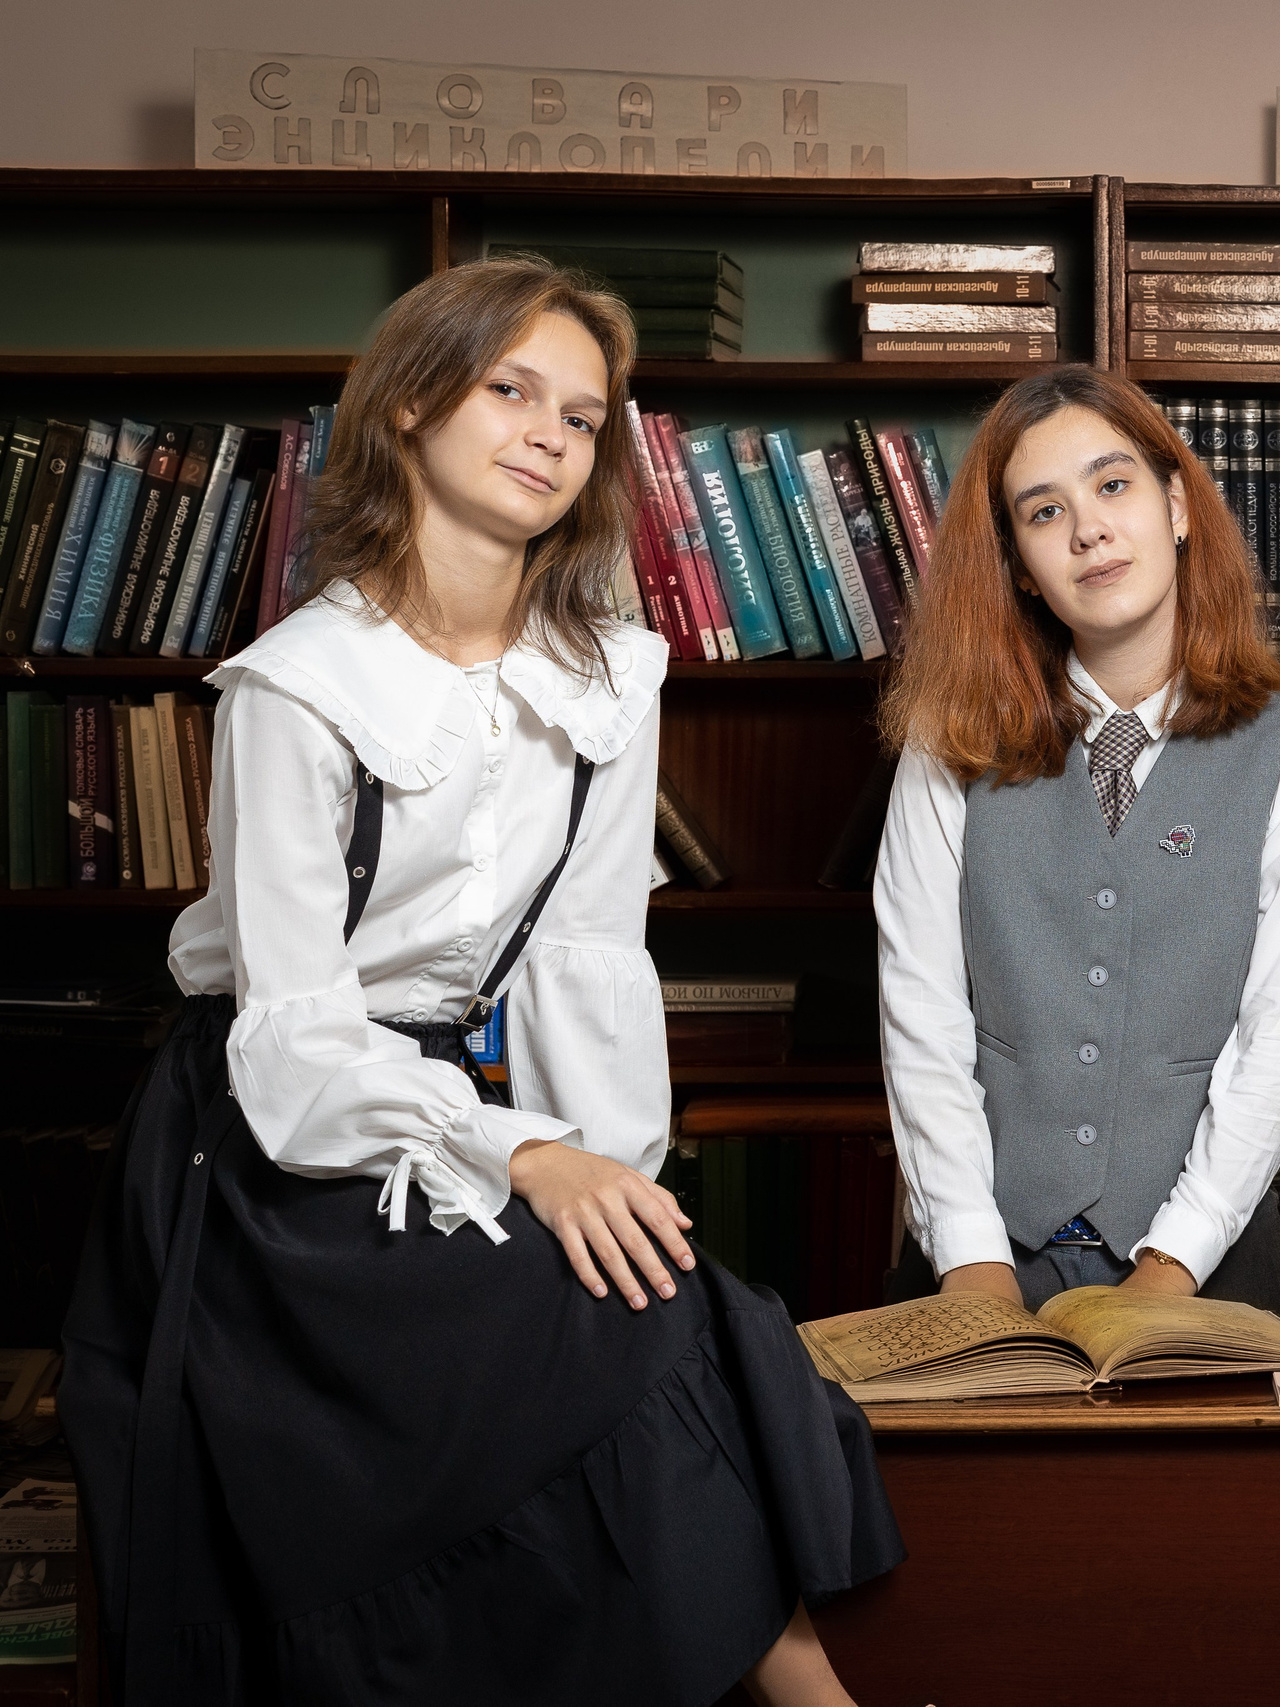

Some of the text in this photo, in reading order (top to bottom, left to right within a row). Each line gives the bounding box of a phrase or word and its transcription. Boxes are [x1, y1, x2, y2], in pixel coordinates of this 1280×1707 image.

[250, 62, 819, 135] СЛОВАРИ
[865, 282, 999, 293] Адыгейская литература
[1016, 275, 1029, 298] 10-11
[876, 341, 1011, 353] Адыгейская литература
[1028, 335, 1042, 359] 10-11
[1143, 335, 1157, 359] 10-11
[856, 427, 903, 547] ЖИЗНЬ ПРИРОДЫ
[45, 528, 82, 621] ХИМИЯ
[77, 531, 116, 620] ФИЗИКА
[111, 489, 160, 639] ФИЗИЧЕСКАЯ ЭНЦИКЛОПЕДИЯ
[140, 495, 191, 644] ФИЗИЧЕСКАЯ ЭНЦИКЛОПЕДИЯ
[173, 586, 195, 628] ЗОЛОТАЯ
[194, 510, 215, 552] ЭТИКЕТА
[198, 499, 242, 635] ЭНЦИКЛОПЕДИЯ ЭТИКЕТА
[702, 469, 757, 607] БИОЛОГИЯ
[767, 535, 806, 622] БИОЛОГИЯ
[672, 595, 690, 637] ЖИВОТНЫЕ
[838, 545, 878, 643] КОМНАТНЫЕ
[74, 707, 83, 796] ТОЛКОВЫЙ СЛОВАРЬ
[87, 707, 97, 797] РУССКОГО ЯЗЫКА
[720, 986, 782, 999] АЛЬБОМ
[880, 1336, 971, 1368] КОМНАТА
